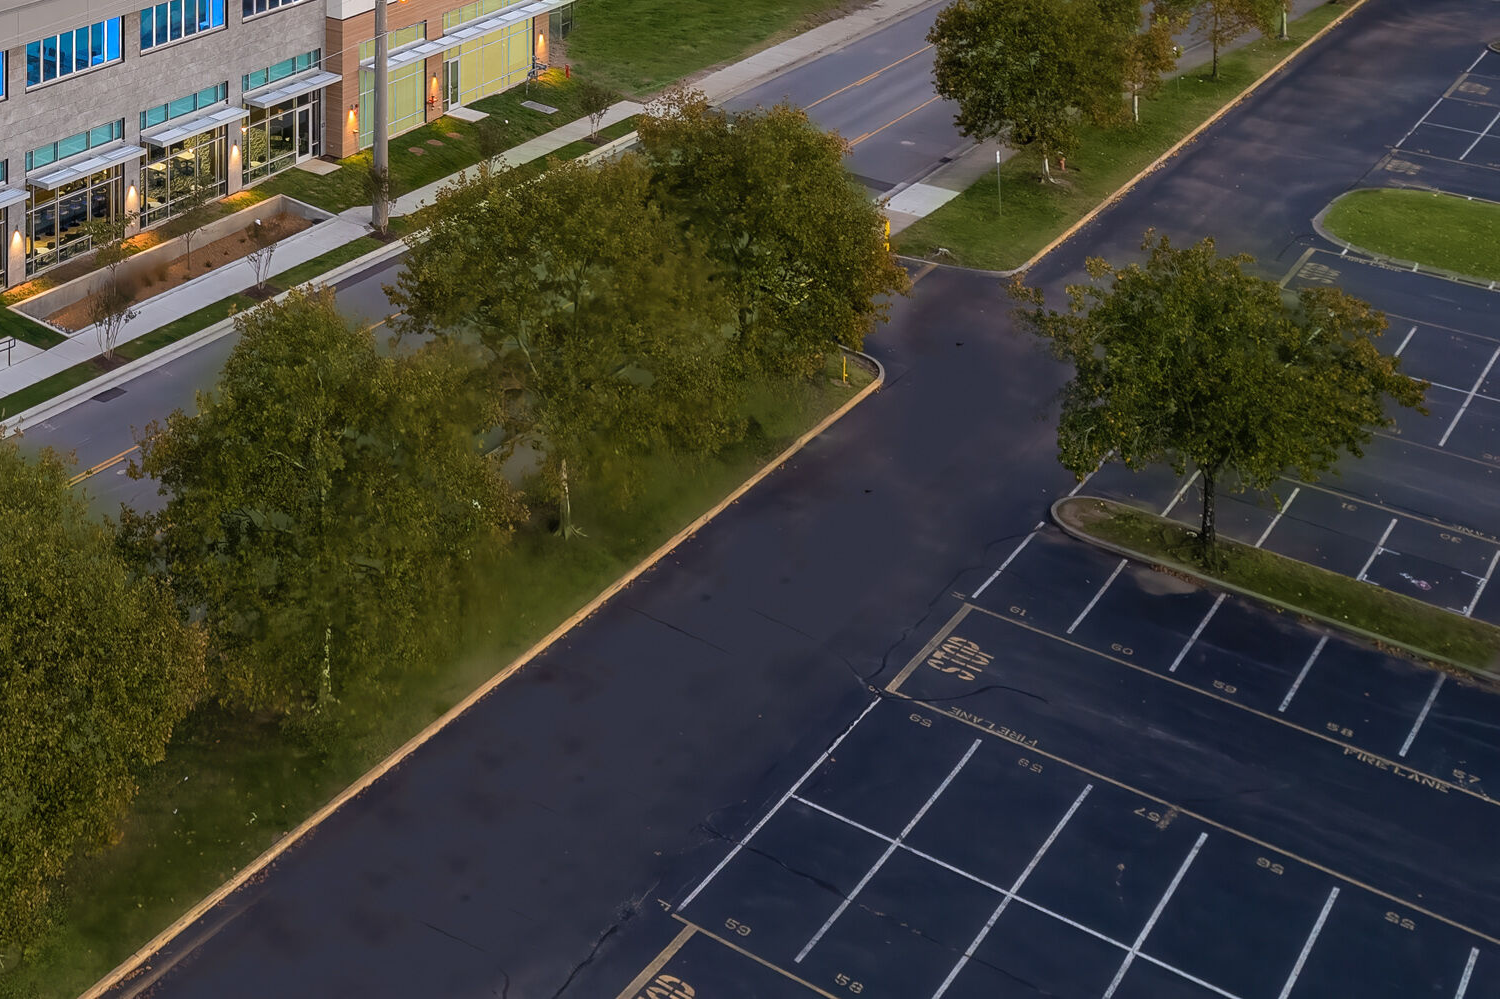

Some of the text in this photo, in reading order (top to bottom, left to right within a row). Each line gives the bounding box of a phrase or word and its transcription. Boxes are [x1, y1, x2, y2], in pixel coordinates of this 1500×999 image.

[1009, 604, 1027, 618] 61
[926, 636, 995, 681] STOP
[1110, 642, 1134, 656] 60
[1212, 679, 1237, 694] 59
[947, 705, 1039, 748] FIRE LANE
[1326, 721, 1354, 738] 58
[1343, 746, 1450, 794] FIRE LANE
[1452, 768, 1481, 785] 57
[723, 917, 752, 937] 59
[1384, 911, 1416, 932] 55
[834, 972, 864, 995] 58
